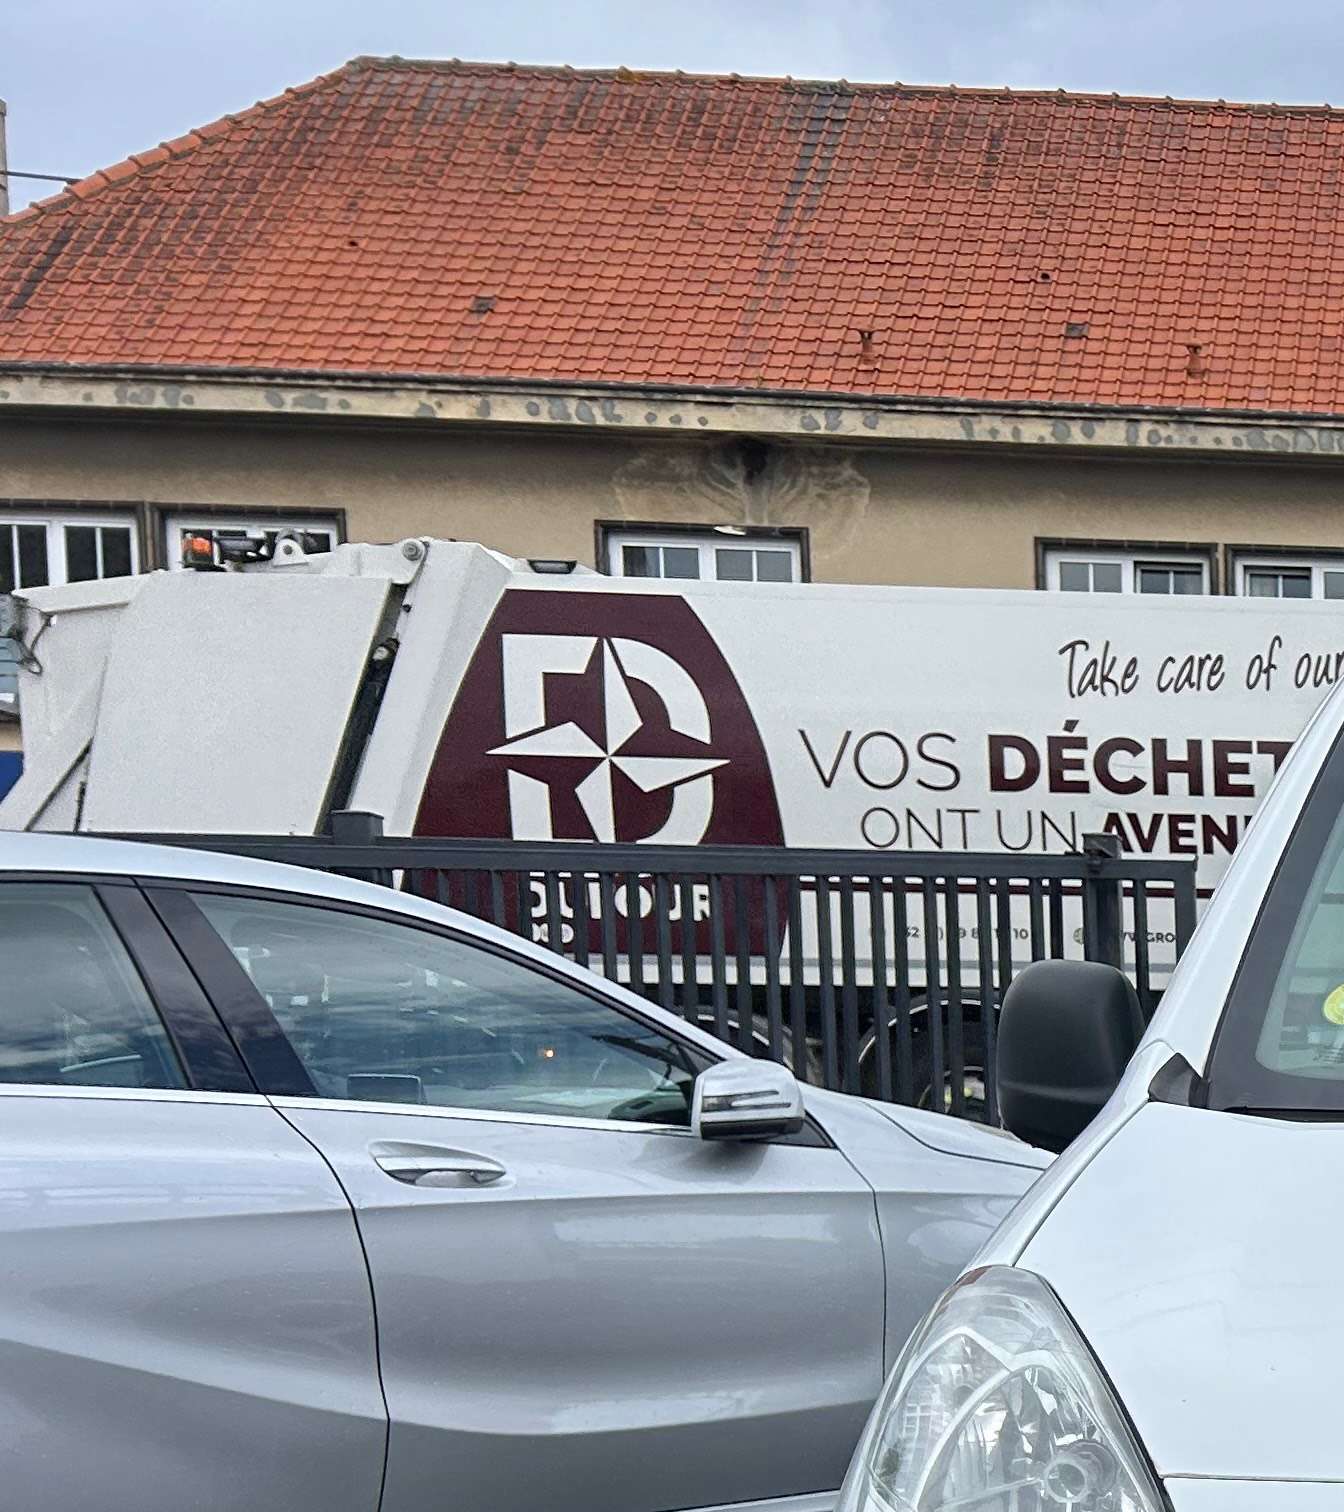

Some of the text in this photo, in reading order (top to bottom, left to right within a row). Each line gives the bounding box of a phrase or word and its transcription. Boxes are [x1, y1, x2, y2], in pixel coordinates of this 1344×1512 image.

[1058, 639, 1140, 698] Take
[1157, 652, 1226, 694] care
[1245, 634, 1283, 691] of
[798, 728, 961, 791] VOS
[860, 806, 1250, 855] ONT UN AVEN
